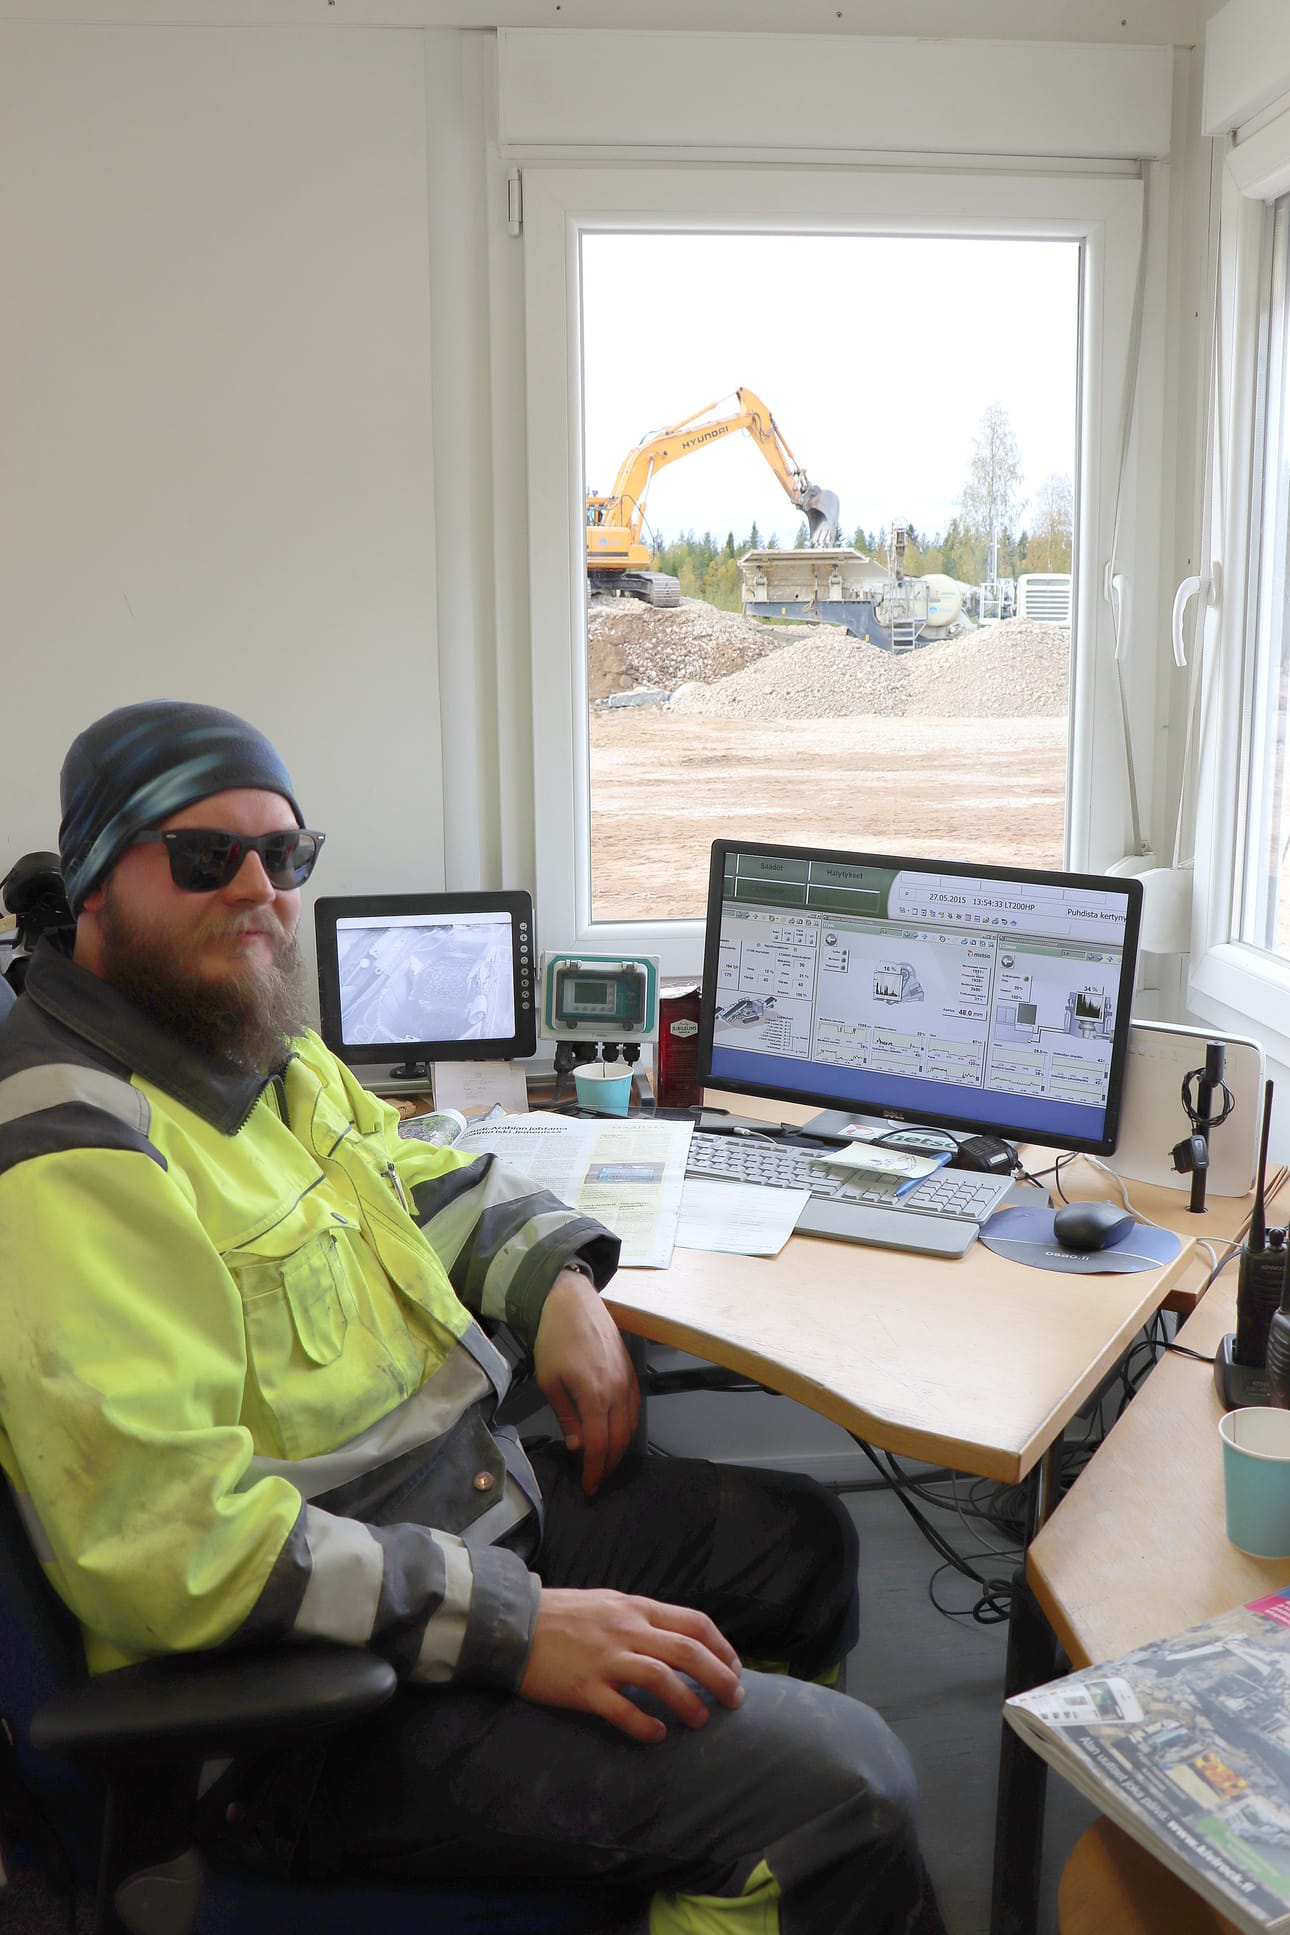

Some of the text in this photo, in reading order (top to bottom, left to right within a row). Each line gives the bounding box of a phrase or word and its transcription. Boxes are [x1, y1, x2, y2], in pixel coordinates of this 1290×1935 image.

[682, 426, 729, 449] HYUNDAI
[929, 893, 1035, 911] 27.05.2015 13:54:33 LT200HP
[1067, 908, 1098, 919] Puhdista
